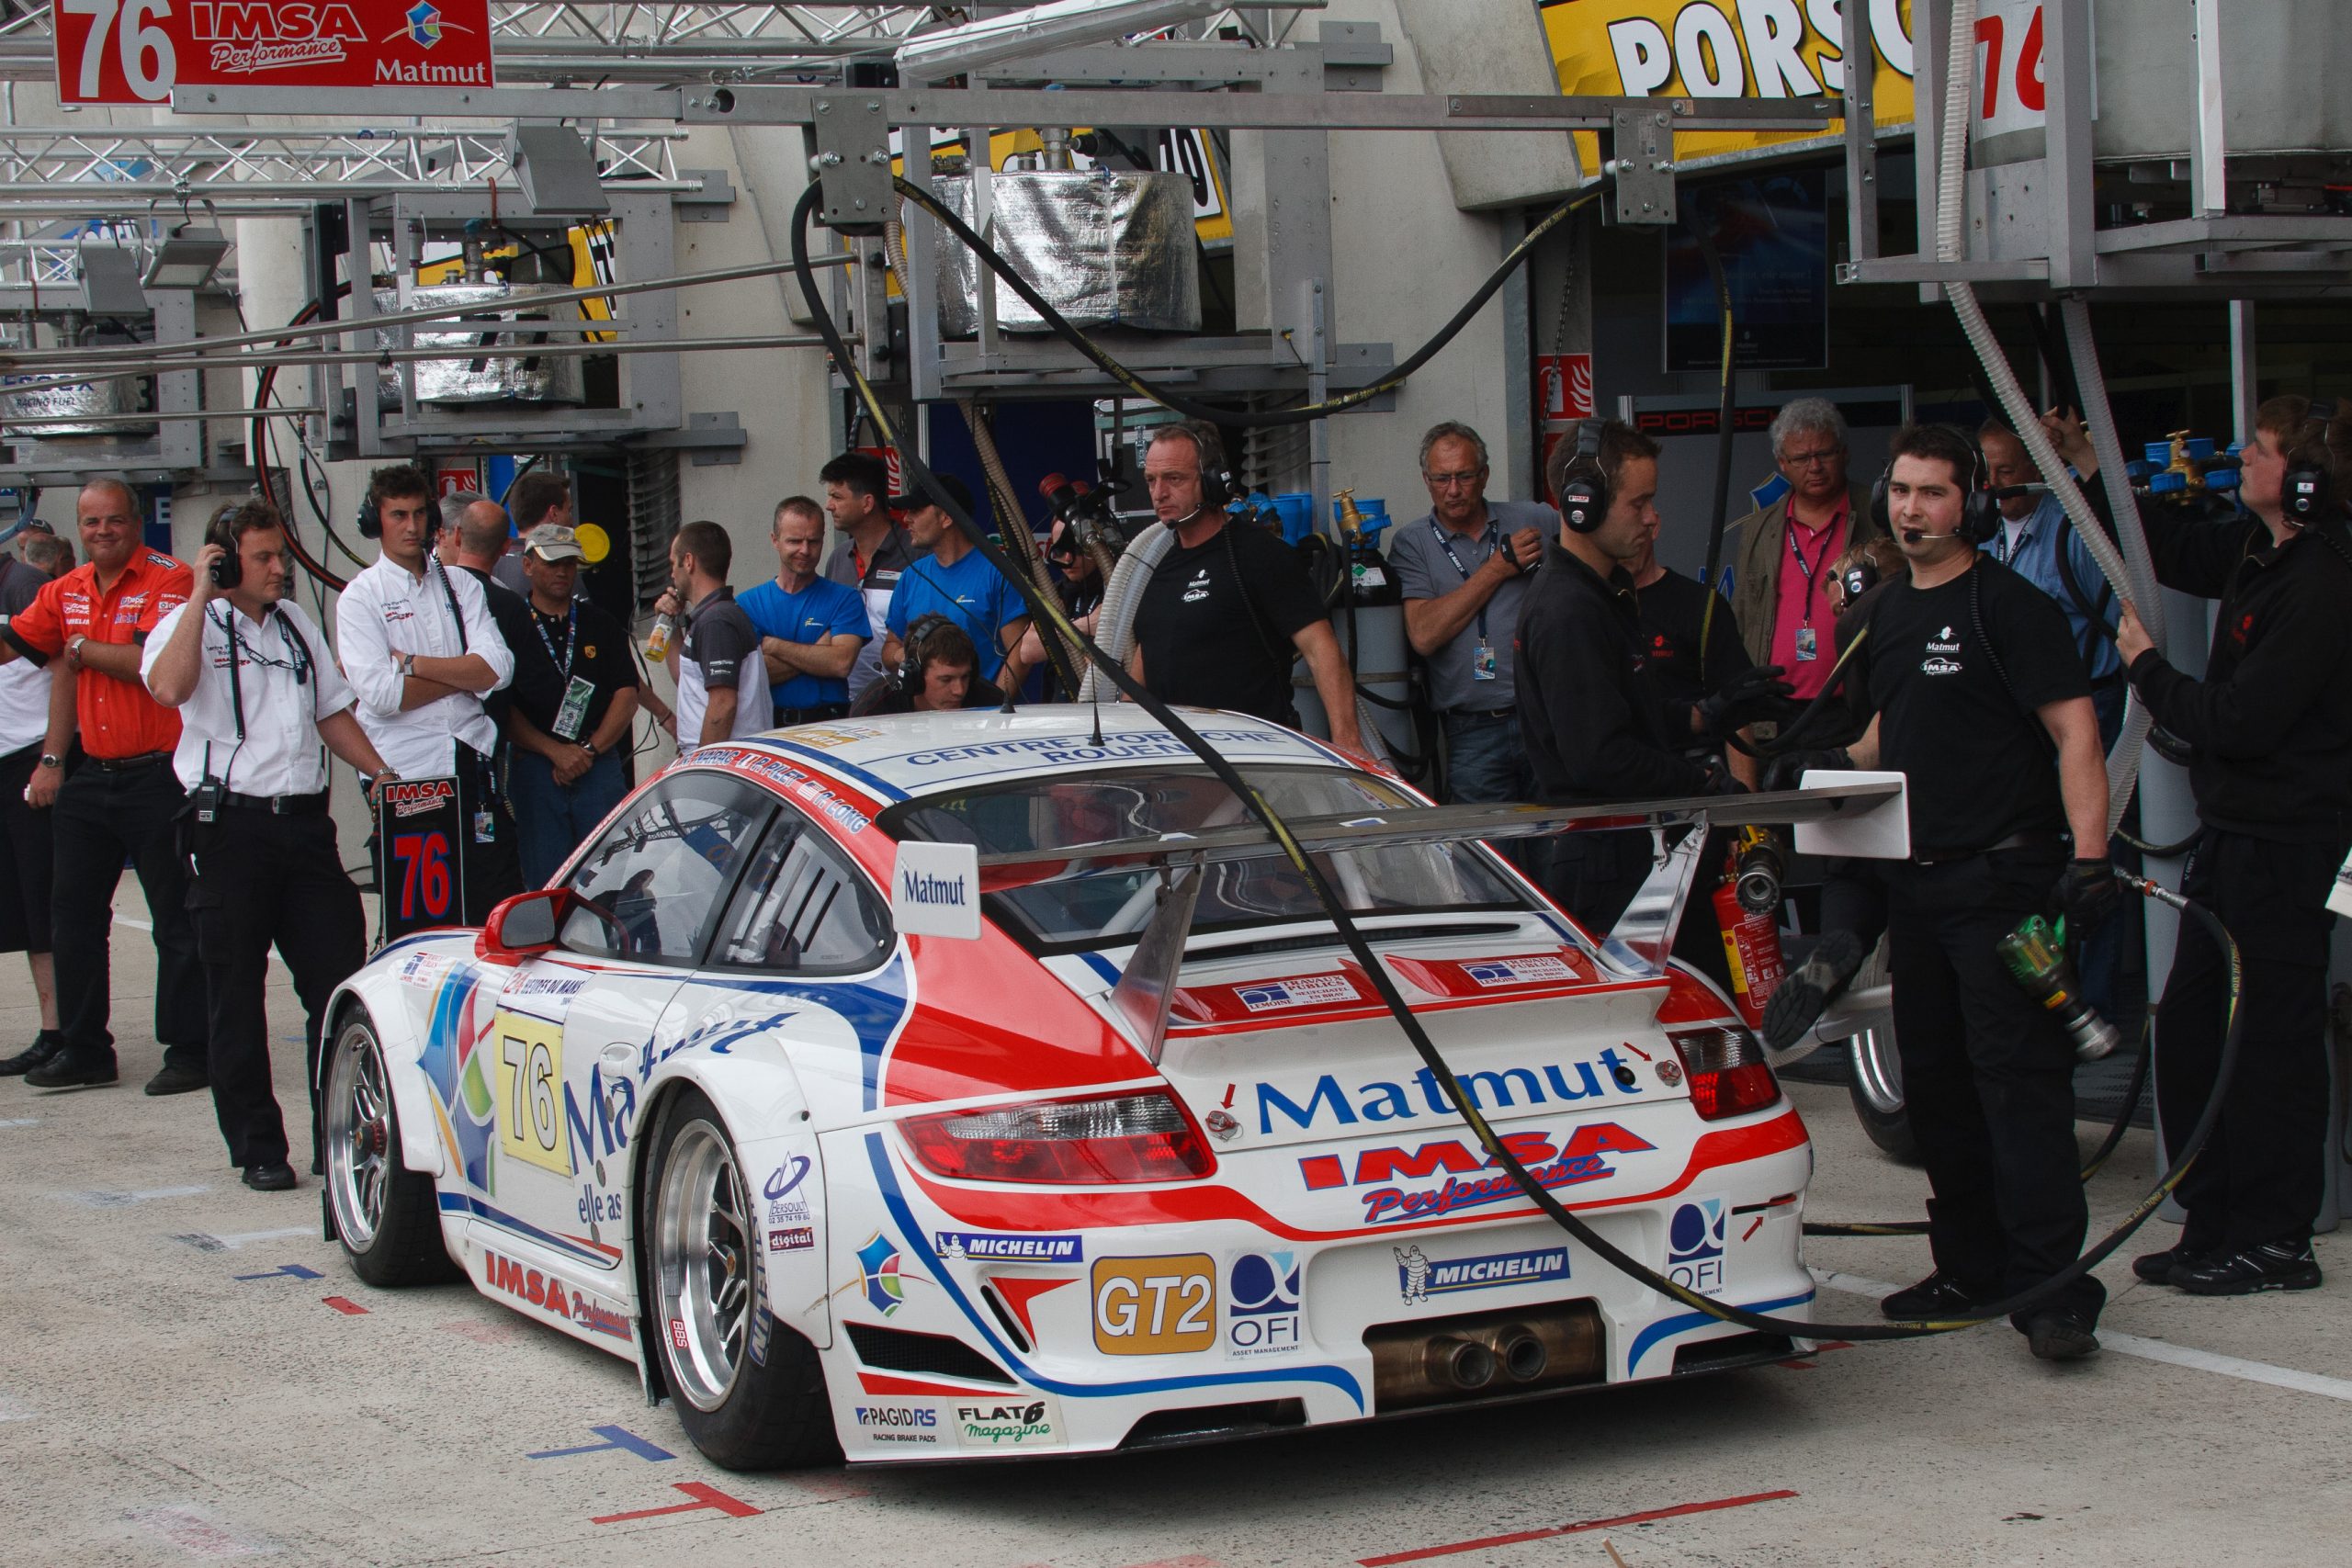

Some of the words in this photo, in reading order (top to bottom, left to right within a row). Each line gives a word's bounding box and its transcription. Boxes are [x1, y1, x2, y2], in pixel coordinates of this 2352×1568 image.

[192, 2, 368, 41] IMSA
[63, 0, 176, 100] 76
[211, 39, 344, 73] Performance
[375, 59, 487, 84] Matmut
[1926, 642, 1960, 651] Matmut
[907, 736, 1077, 766] CENTRE
[1045, 743, 1197, 763] ROUEN
[386, 781, 455, 802] IMSA
[396, 797, 445, 818] Performance
[824, 798, 871, 834] LONG
[393, 830, 452, 920] 76
[904, 874, 966, 907] Matmut
[503, 971, 531, 995] 24
[557, 978, 588, 995] MANS
[1282, 976, 1343, 987] TRAVAUX
[1288, 981, 1345, 991] PUBLICS
[1295, 987, 1349, 996] NEUFCHATEL
[1480, 976, 1521, 985] LEMOINE
[1250, 998, 1294, 1010] LEMOINE
[1322, 991, 1345, 999] BRAY
[503, 1034, 557, 1152] 76
[1255, 1047, 1643, 1134] Matmut
[1298, 1122, 1659, 1191] IMSA
[579, 1183, 605, 1224] elle
[772, 1233, 811, 1247] digital
[969, 1238, 1075, 1256] MICHELIN
[1434, 1253, 1564, 1285] MICHELIN
[1668, 1259, 1723, 1291] OFI
[485, 1249, 571, 1320] IMSA
[1096, 1274, 1212, 1337] GT2
[673, 1320, 687, 1348] BBS
[1230, 1315, 1298, 1347] OFI
[1232, 1348, 1253, 1357] ASSET
[1254, 1344, 1299, 1355] MANAGEMENT
[873, 1433, 896, 1441] RACING
[897, 1434, 918, 1442] BRAKE
[919, 1435, 937, 1443] PADS
